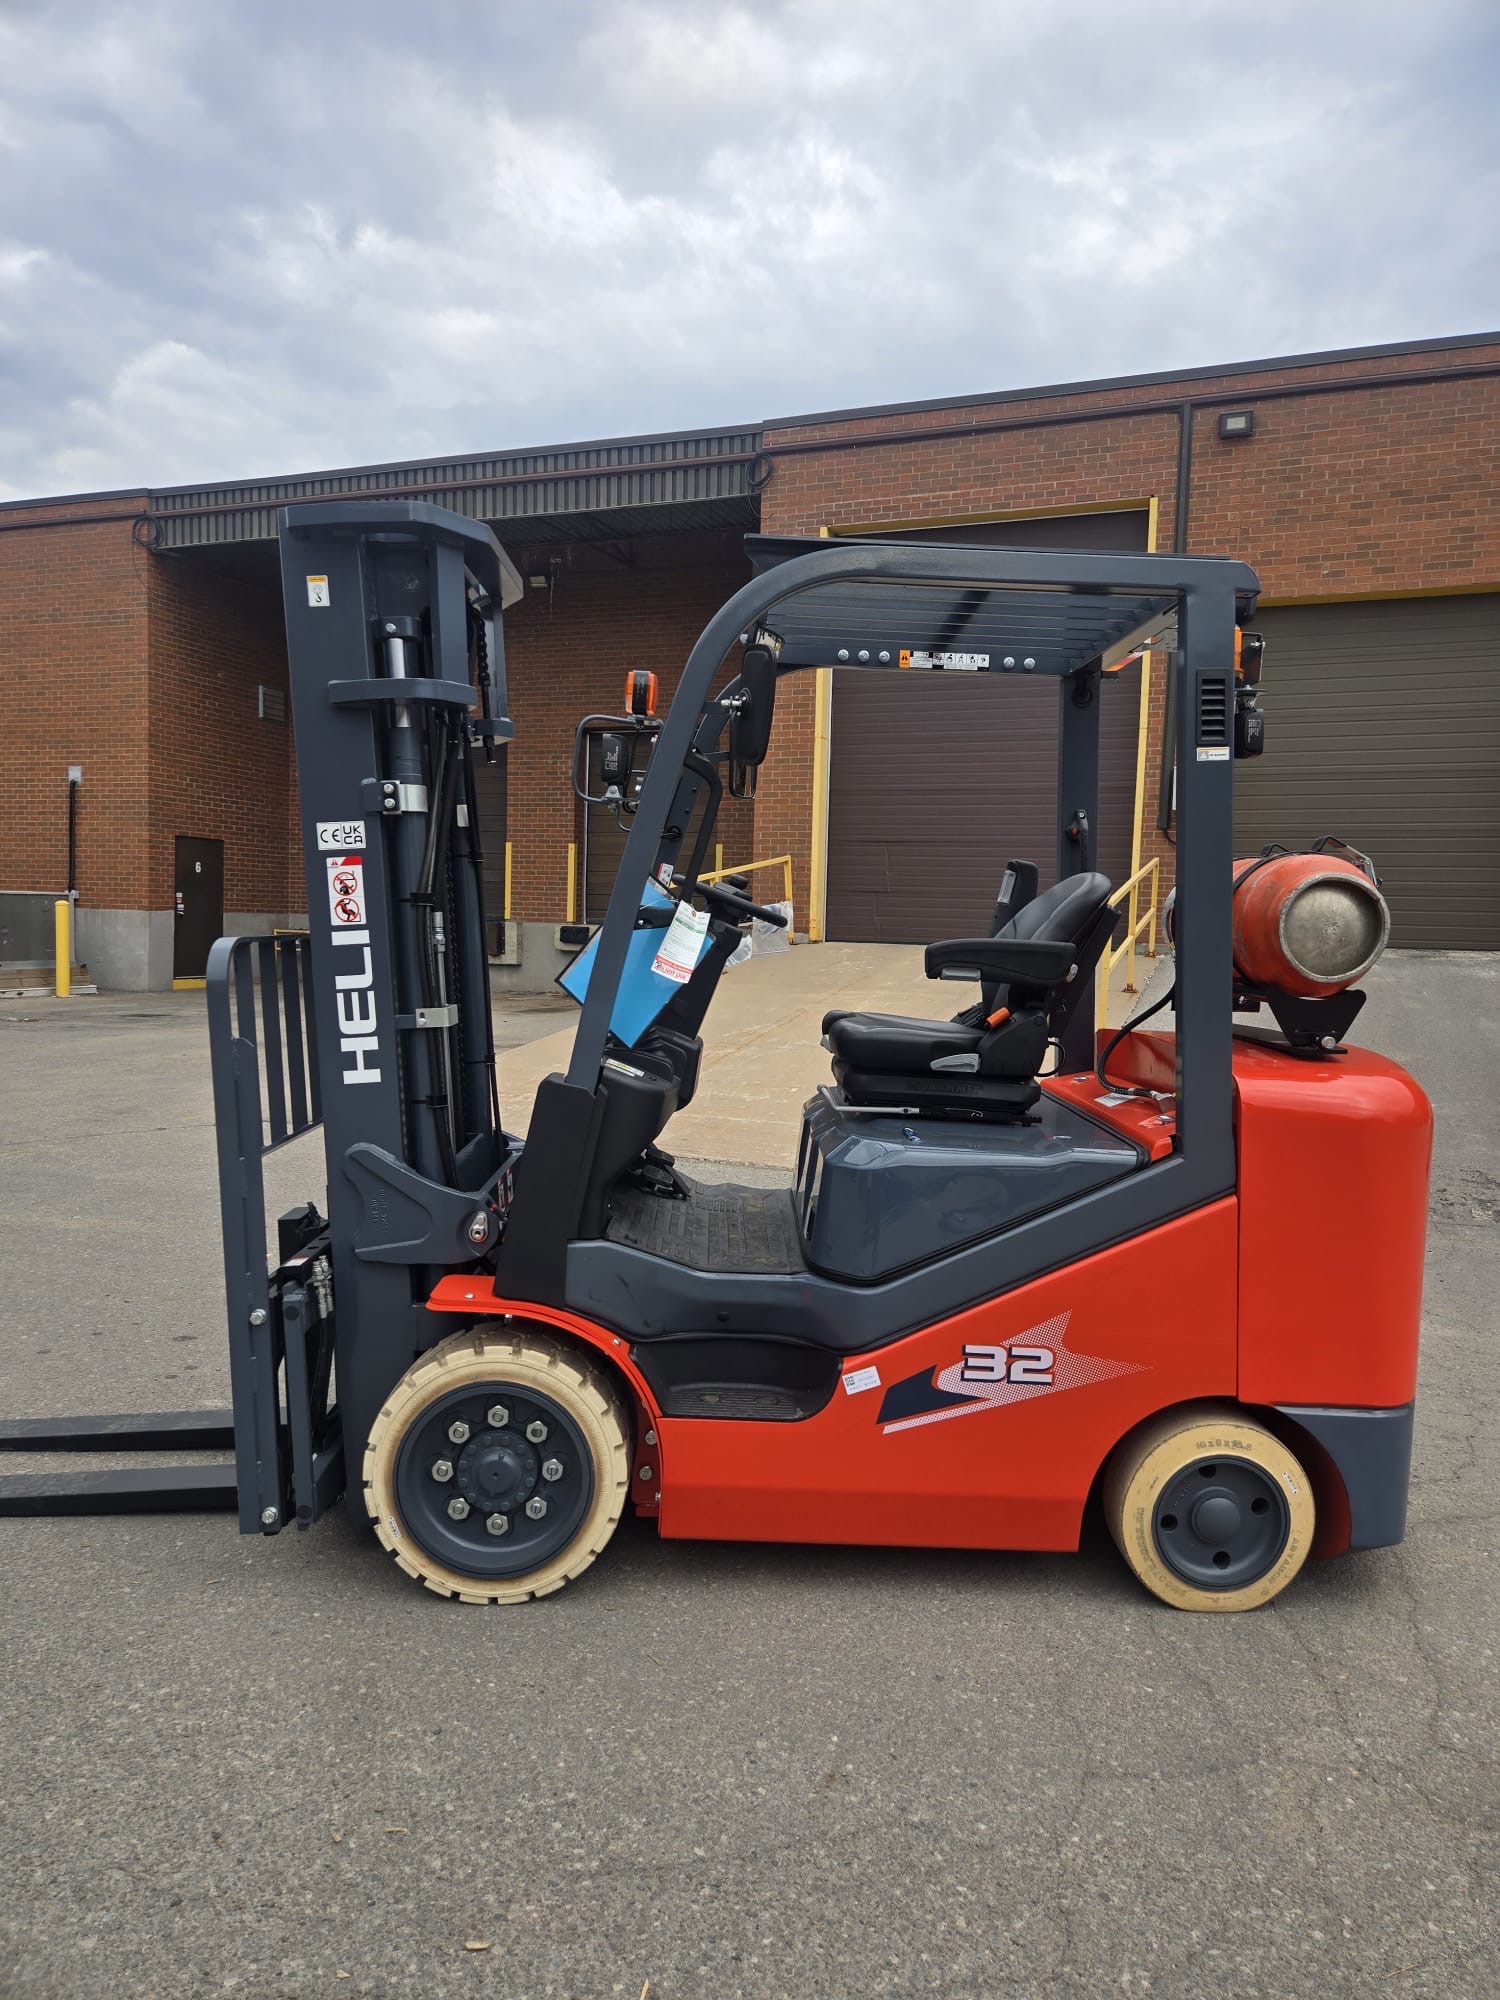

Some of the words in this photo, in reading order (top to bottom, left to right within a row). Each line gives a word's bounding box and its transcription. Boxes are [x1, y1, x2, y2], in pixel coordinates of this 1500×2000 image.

[320, 828, 341, 843] CE
[342, 825, 362, 835] UK
[343, 835, 363, 845] CA
[195, 861, 202, 873] 6
[331, 929, 382, 1085] HELI
[961, 1344, 1054, 1386] 32
